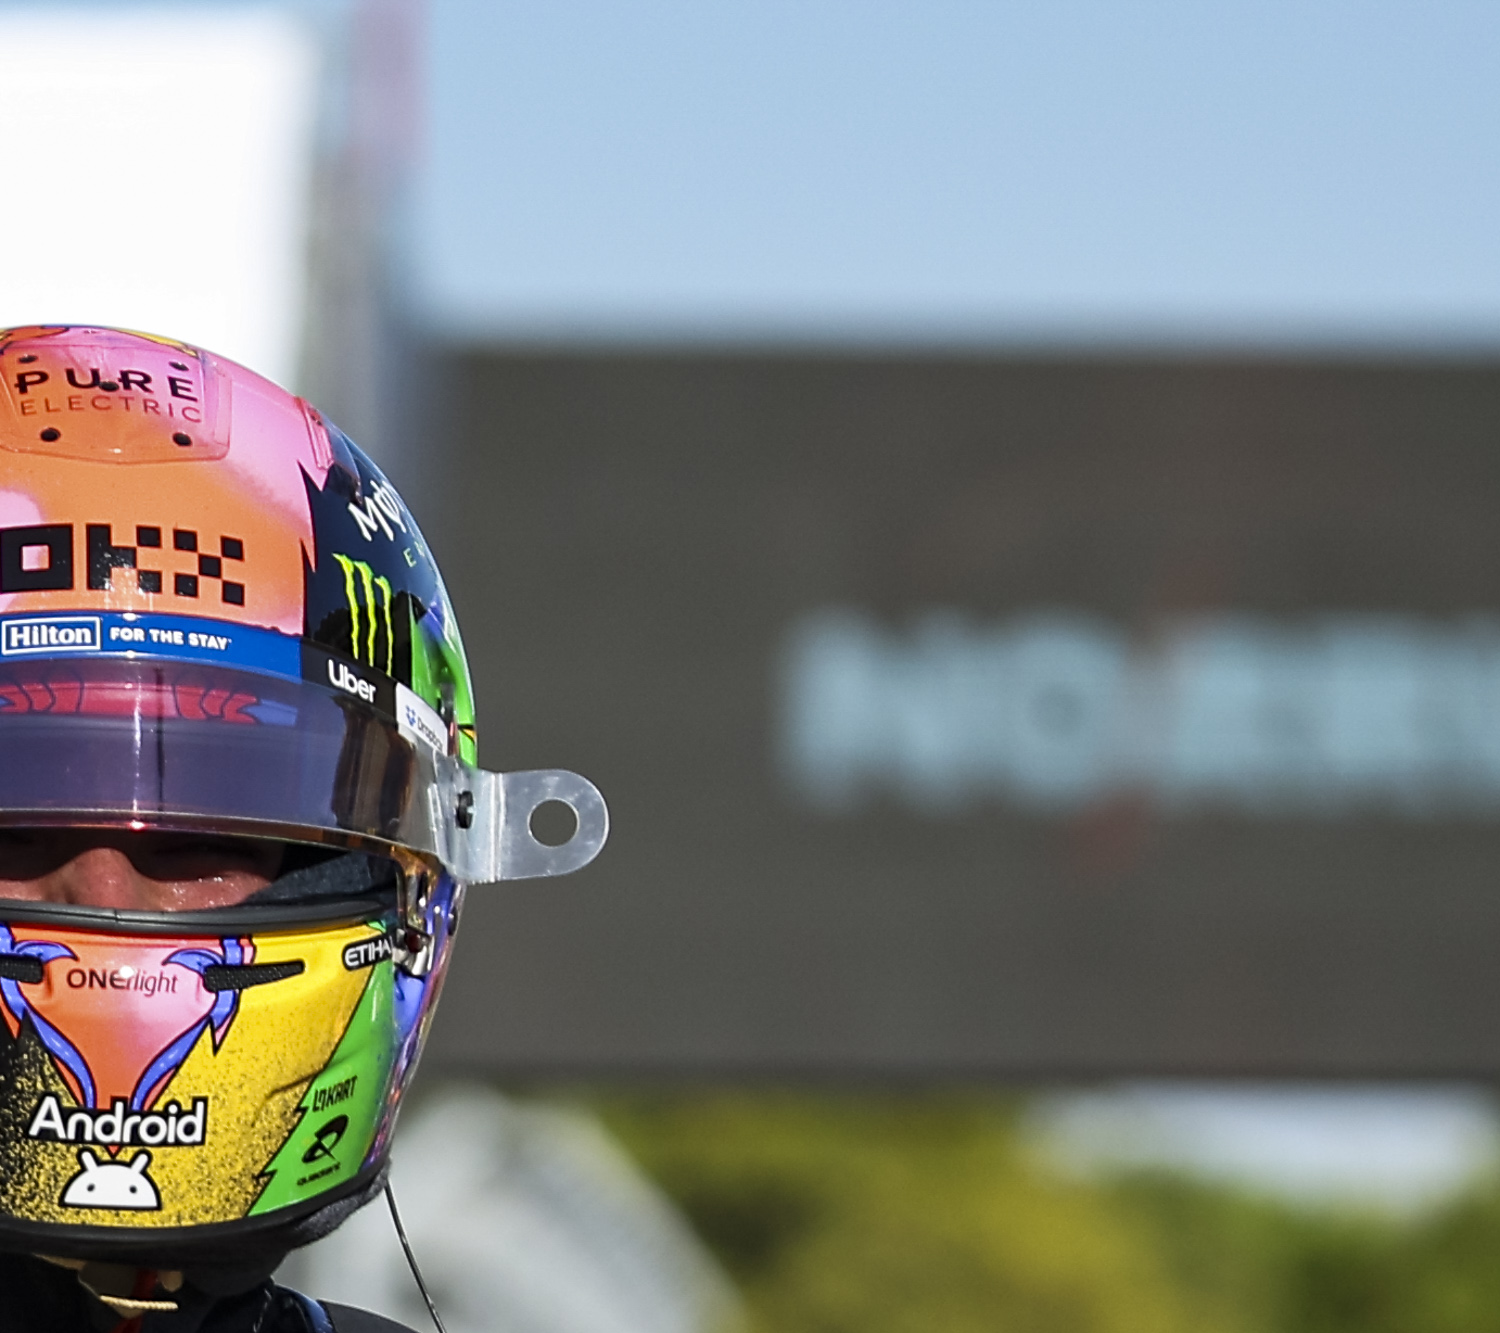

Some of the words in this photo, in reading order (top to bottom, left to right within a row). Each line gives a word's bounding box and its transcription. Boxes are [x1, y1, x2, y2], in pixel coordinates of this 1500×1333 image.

[15, 368, 198, 402] PURE
[20, 395, 202, 423] ELECTRIC
[9, 625, 92, 647] Hilton
[110, 627, 146, 642] FOR
[149, 629, 185, 645] THE
[188, 632, 229, 650] STAY
[327, 659, 377, 703] Uber
[28, 1095, 206, 1145] Android
